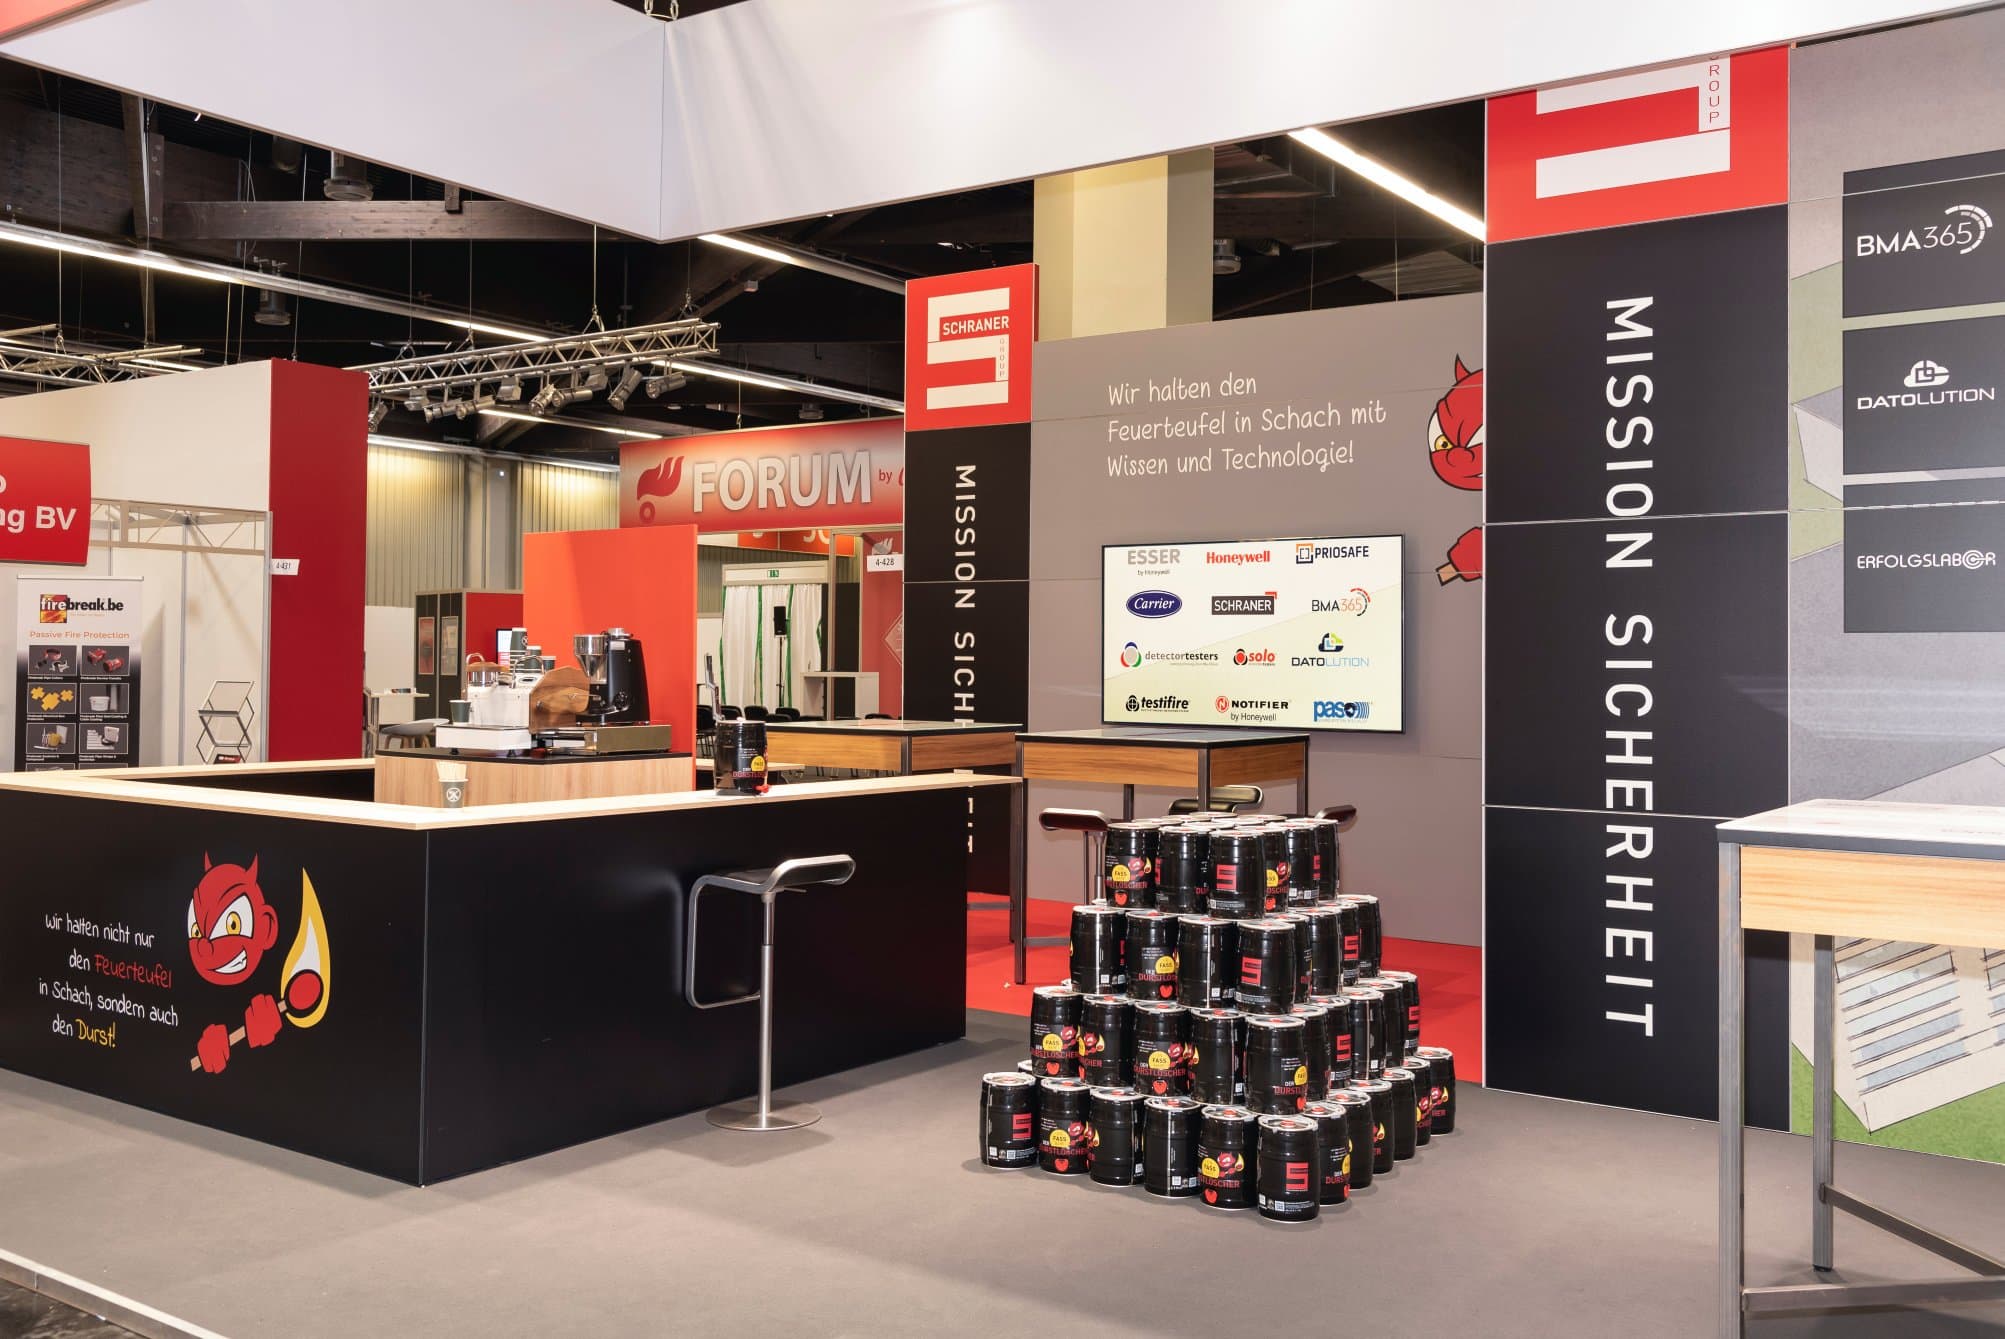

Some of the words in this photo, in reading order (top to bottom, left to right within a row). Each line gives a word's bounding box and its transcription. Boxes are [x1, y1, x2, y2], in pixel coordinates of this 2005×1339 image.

[1709, 56, 1720, 123] ROUP
[1857, 222, 1973, 256] BMA365
[943, 316, 1009, 335] SCHRANER
[1108, 383, 1140, 406] Wir
[1149, 376, 1212, 402] halten
[1220, 371, 1256, 396] den
[1857, 387, 1996, 410] DATOLUTION
[1108, 410, 1225, 443] Feuerteufel
[1235, 411, 1252, 433] in
[1261, 402, 1341, 432] Schach
[1351, 399, 1387, 425] mit
[1606, 296, 1653, 568] MISSION
[1107, 454, 1168, 477] Wissen
[1177, 447, 1212, 473] und
[1221, 440, 1354, 472] Technologie!
[692, 449, 872, 513] FORUM
[879, 469, 892, 484] by
[35, 505, 77, 530] BV
[955, 465, 976, 608] MISSION
[1127, 548, 1181, 565] ESSER
[1206, 550, 1271, 566] Honeywell
[1315, 546, 1369, 558] PRIOSAFE
[1857, 550, 1996, 569] ERFOLGSLABOR
[1134, 597, 1175, 609] Carrier
[1214, 599, 1272, 612] SCHRANER
[1311, 598, 1363, 612] BMA365
[1145, 651, 1219, 661] detectortesters
[1248, 649, 1275, 662] solo
[1291, 657, 1369, 667] DATOLUTION
[1141, 695, 1189, 709] testifire
[1231, 700, 1289, 709] NOTIFIER
[1230, 712, 1239, 722] by
[1240, 712, 1277, 722] Honeywell
[1605, 614, 1653, 1036] SICHERHEIT
[66, 912, 99, 938] halten
[104, 922, 130, 944] nicht
[135, 932, 155, 948] nur
[69, 948, 90, 971] den
[95, 954, 172, 989] Feuerteufel
[39, 977, 48, 996] in
[52, 981, 93, 1011] Schach,
[97, 993, 145, 1019] sondern
[149, 1004, 178, 1027] auch
[52, 1013, 73, 1037] den
[75, 1018, 116, 1048] Durst!
